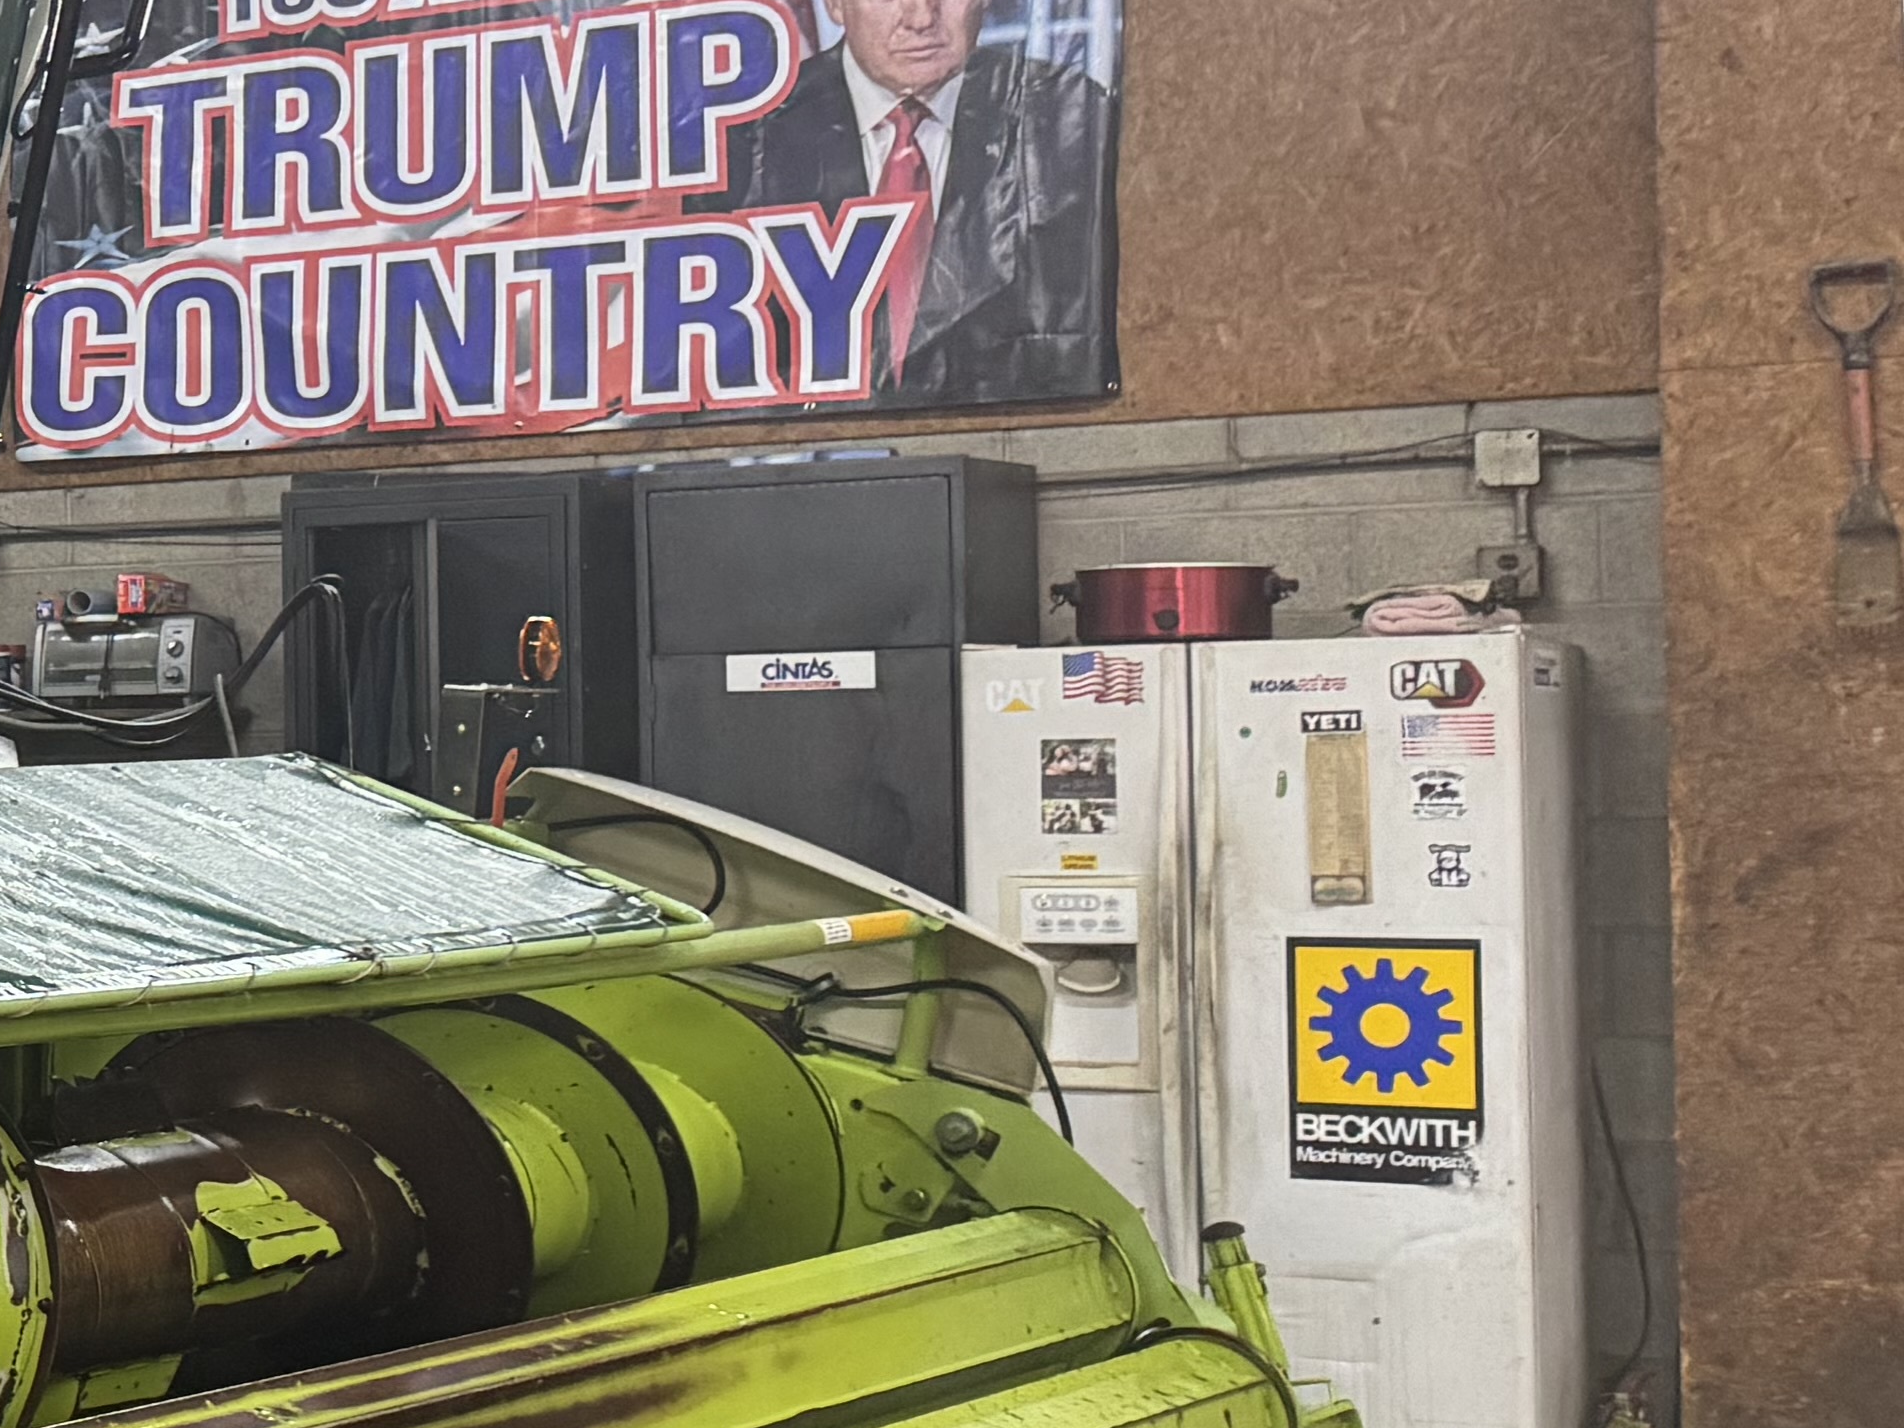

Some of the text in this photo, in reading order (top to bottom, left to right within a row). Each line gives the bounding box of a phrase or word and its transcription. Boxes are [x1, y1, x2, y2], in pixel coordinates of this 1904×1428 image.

[121, 4, 792, 239] TRUMP
[22, 202, 914, 440] COUNTRY
[1393, 660, 1462, 699] CAT
[1303, 713, 1358, 731] YETI
[1296, 1113, 1477, 1148] BECKWITH
[1296, 1146, 1386, 1169] Machinery
